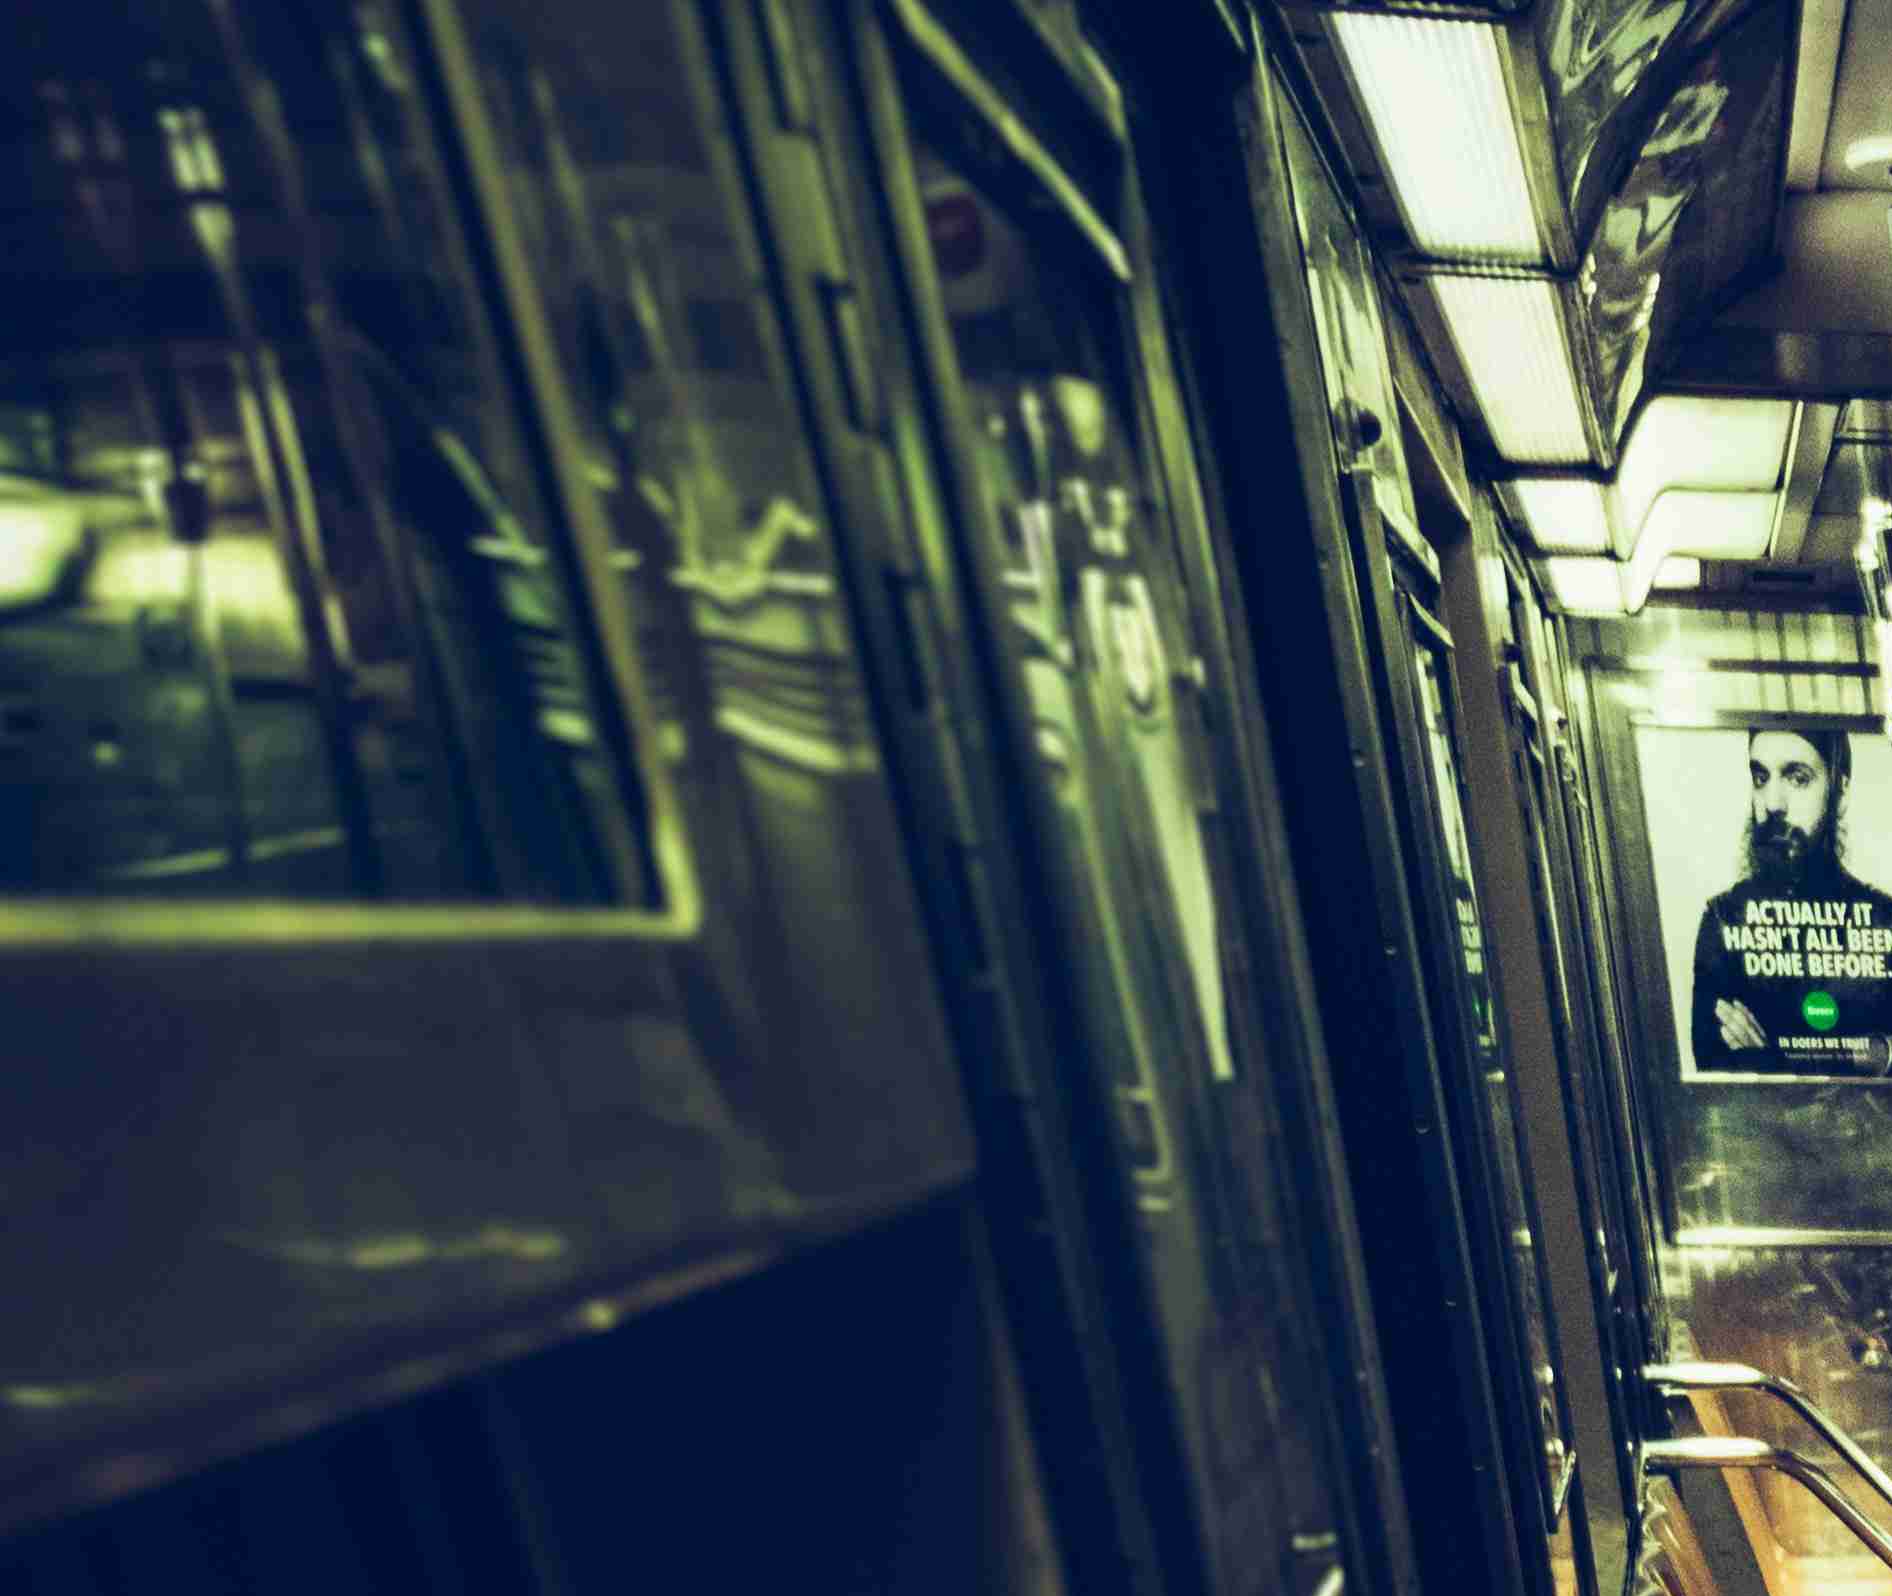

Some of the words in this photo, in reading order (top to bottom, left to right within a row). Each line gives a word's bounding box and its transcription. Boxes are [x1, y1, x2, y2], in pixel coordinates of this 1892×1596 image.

[1746, 900, 1852, 928] ACTUALLY,
[1853, 903, 1872, 926] IT
[1723, 925, 1800, 951] HASN'T
[1806, 928, 1844, 951] ALL
[1744, 953, 1804, 977] DONE
